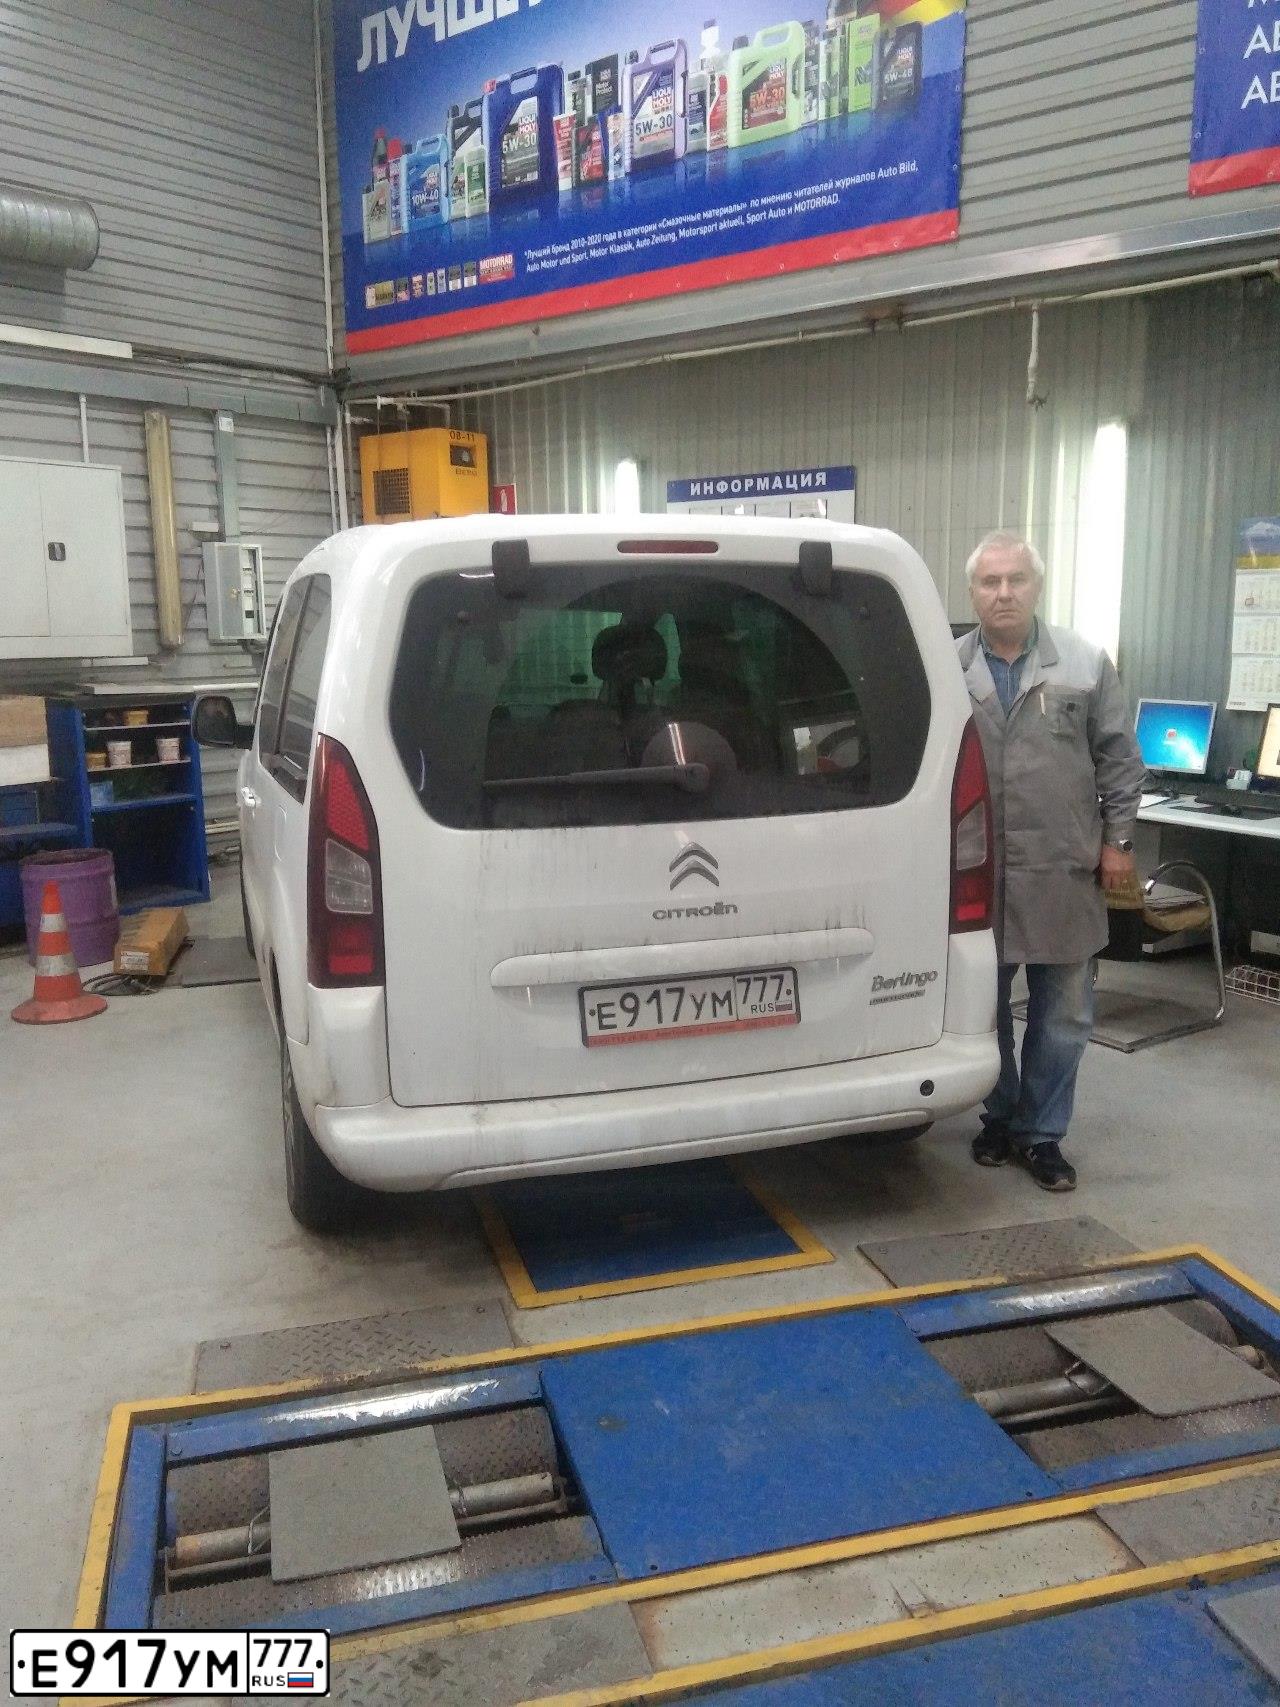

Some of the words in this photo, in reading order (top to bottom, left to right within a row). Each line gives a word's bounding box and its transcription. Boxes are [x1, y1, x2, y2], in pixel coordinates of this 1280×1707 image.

[357, 0, 542, 72] ЛУЧШ
[635, 113, 673, 136] 5W-30
[502, 132, 538, 154] 5W-30
[750, 199, 760, 208] по
[761, 192, 792, 206] мнению
[794, 179, 834, 198] читателей
[835, 171, 876, 190] журналов
[878, 166, 898, 179] Auto
[899, 160, 918, 175] Bild,
[589, 247, 609, 259] Motor
[636, 238, 651, 249] Auto
[679, 221, 718, 239] Motorsport
[746, 209, 767, 225] Sport
[767, 208, 786, 220] Auto
[690, 471, 827, 496] ИНФОРМАЦИЯ
[736, 973, 786, 1005] 777
[871, 969, 939, 993] Berlingo
[750, 1002, 775, 1014] RUS
